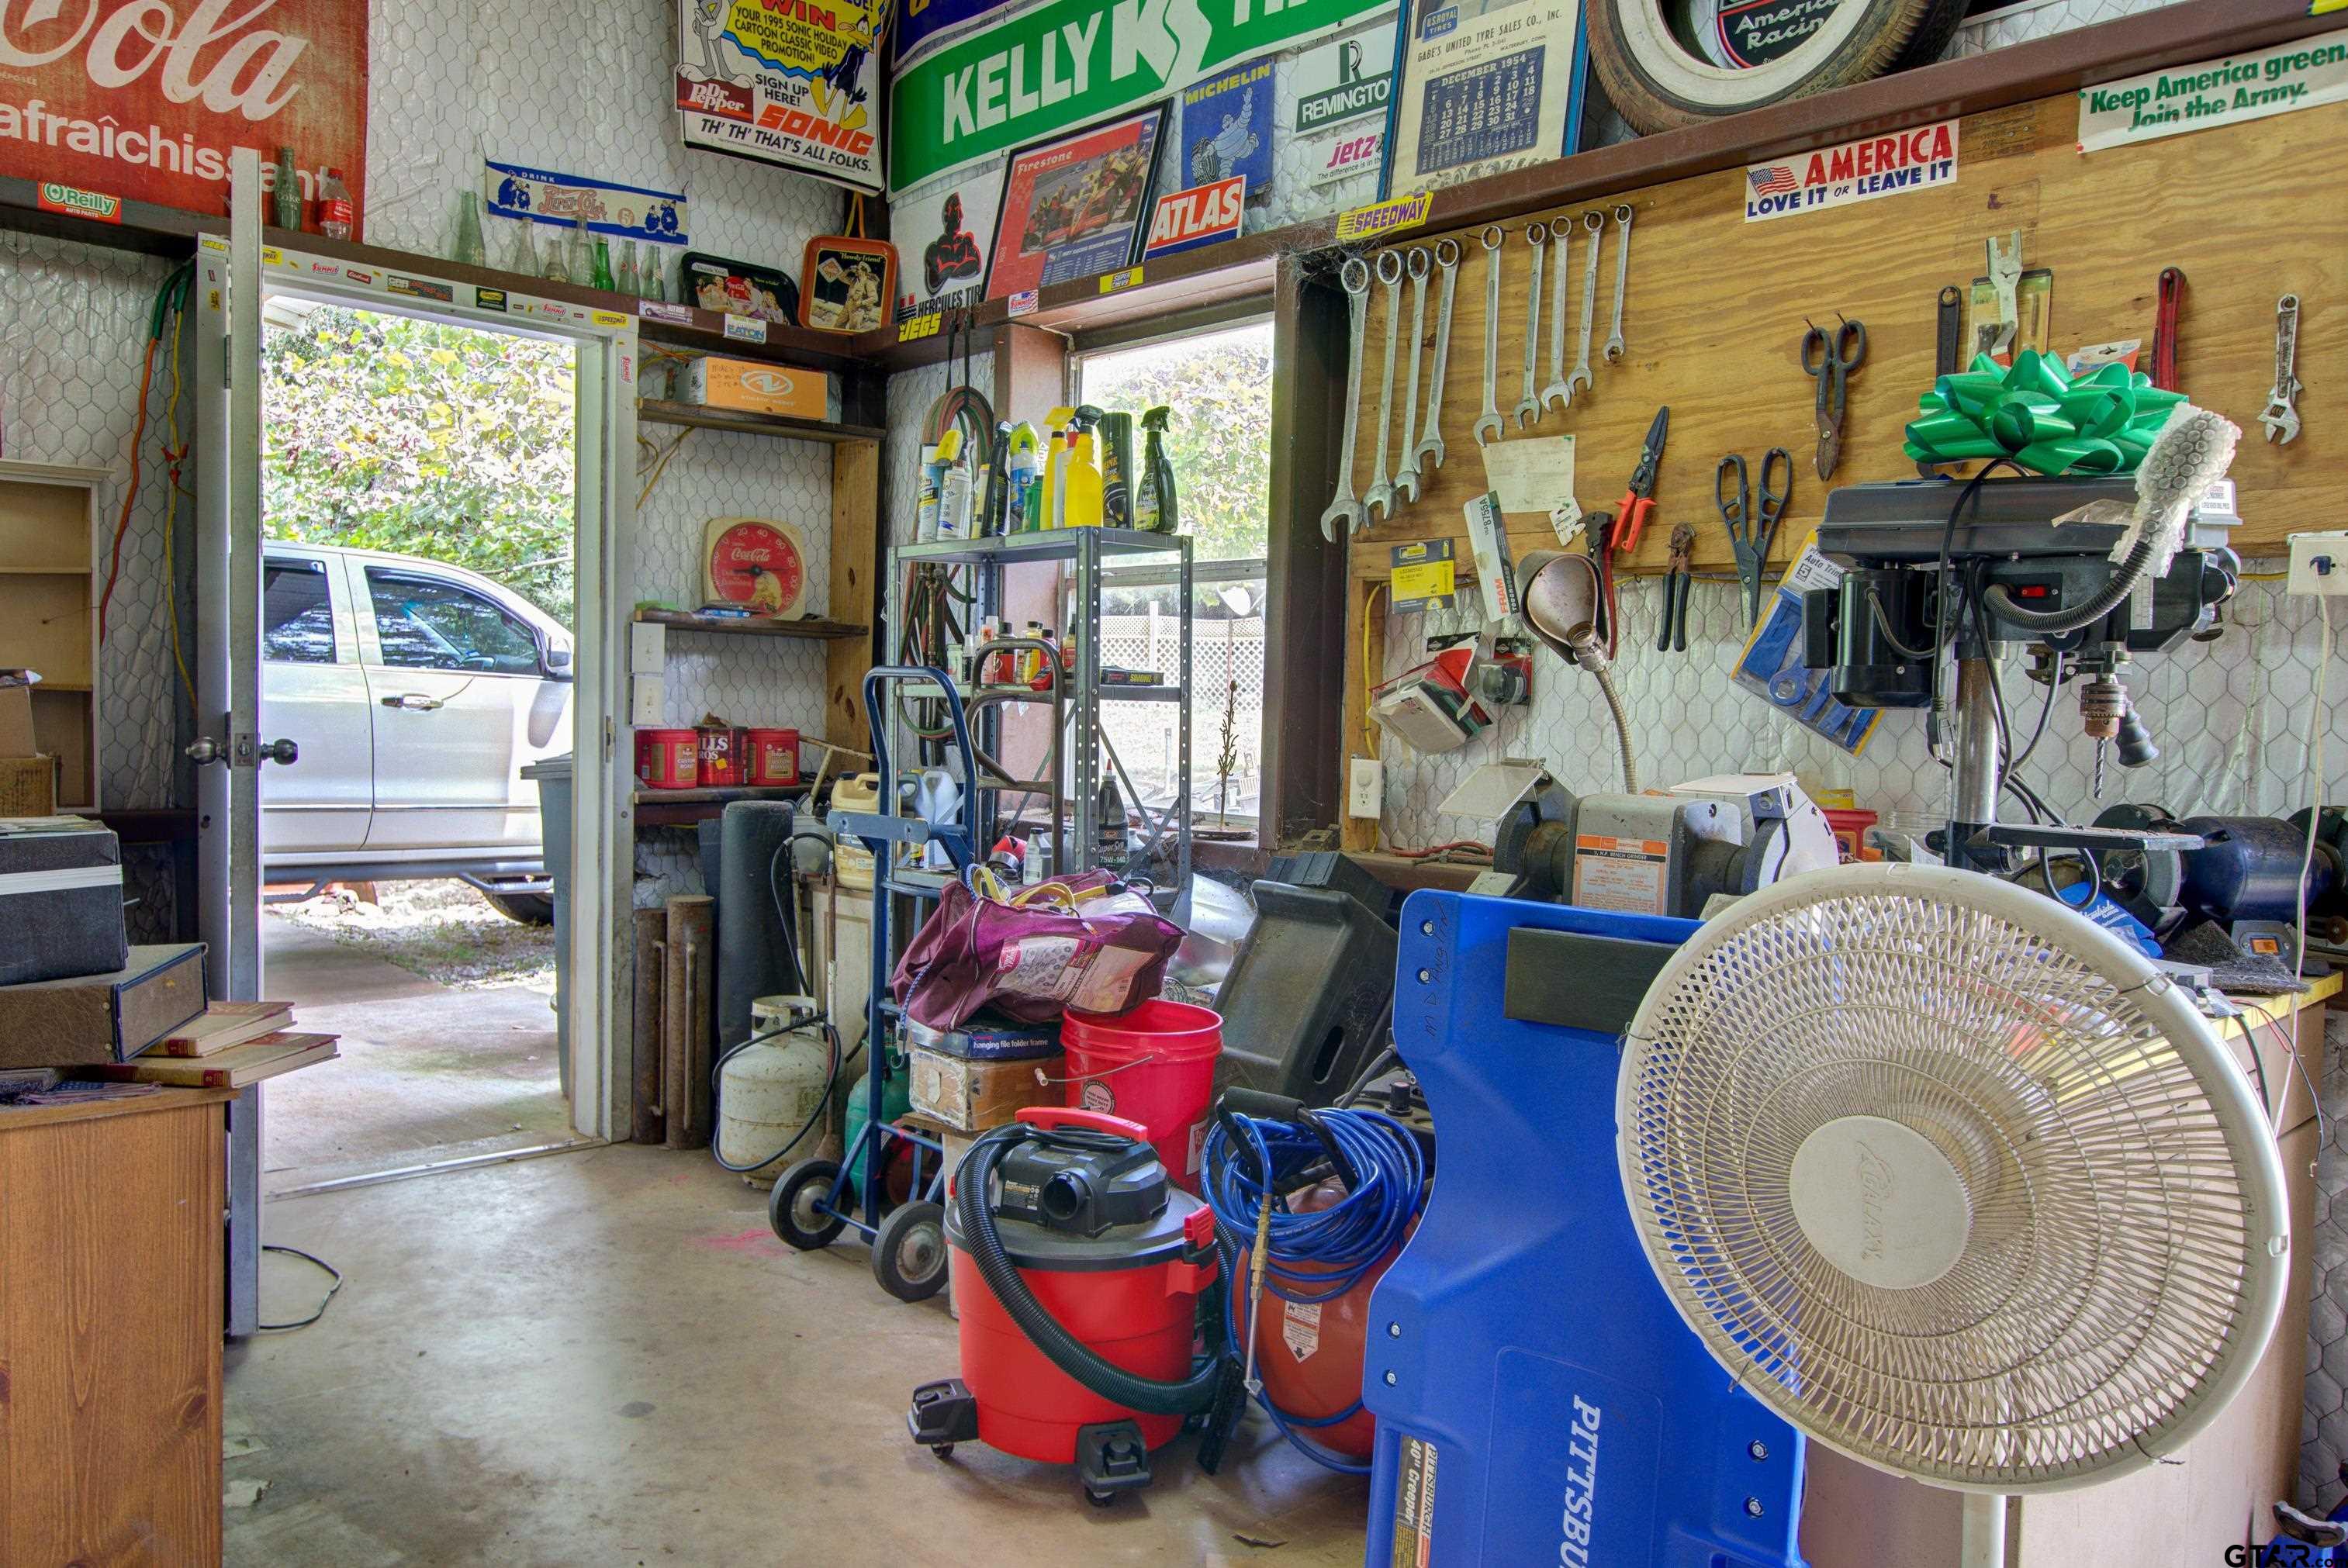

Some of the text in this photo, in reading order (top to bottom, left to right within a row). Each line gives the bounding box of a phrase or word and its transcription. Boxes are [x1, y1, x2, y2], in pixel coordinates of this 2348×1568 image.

[735, 19, 838, 60] CARTOON CLASSIC VIDEO
[736, 7, 847, 50] YOUR 1995 SONIC HOLIDAY
[1417, 45, 1441, 63] GABE'S
[1445, 36, 1472, 54] UNITED
[1476, 27, 1495, 43] TYRE
[1499, 19, 1522, 36] SALES
[1429, 22, 1452, 34] TIRES
[1746, 17, 1824, 50] Racin
[761, 39, 815, 64] PROMOTION!
[1339, 40, 1363, 84] R
[756, 74, 810, 96] SIGN UP
[943, 11, 1103, 145] KELLY
[1185, 64, 1271, 107] MICHELIN
[1441, 54, 1527, 87] DECEMBER 1954
[1478, 64, 1535, 89] 1 2 3 4
[2090, 43, 2348, 114] Keep America green.
[689, 83, 745, 112] Pepper
[707, 83, 729, 100] Dr
[764, 88, 801, 107] HERE!
[1302, 78, 1391, 124] REMINGTO
[1441, 85, 1536, 119] 13 14 15 16 17 18
[1445, 75, 1536, 109] 6 7 8 9 10 11
[2128, 81, 2308, 133] Join the Army.
[756, 103, 876, 157] SONIC
[1440, 101, 1517, 130] 20 21 22 23 24
[1440, 112, 1516, 140] 27 28 29 30 31
[0, 99, 329, 202] afraîchisant
[700, 118, 724, 134] TH'
[728, 124, 752, 140] TH'
[755, 130, 801, 153] THAT'S
[802, 145, 825, 161] ALL
[828, 150, 872, 172] FOLKS.
[1017, 150, 1074, 174] Firestone
[1803, 124, 1954, 188] AMERICA
[521, 171, 555, 183] DRINK
[1317, 171, 1329, 181] The
[1330, 163, 1359, 178] difference
[1367, 158, 1373, 167] in
[1747, 160, 1953, 219] LOVE IT OR LEAVE IT
[1149, 181, 1241, 245] ATLAS
[1354, 198, 1425, 233] SPEEDWAY
[918, 284, 981, 318] HERCULES TIR
[898, 313, 942, 343] JEGS
[757, 529, 768, 537] 40
[1804, 554, 1823, 569] Auto
[1494, 577, 1509, 614] FRAM
[973, 1041, 1000, 1051] hanging
[1409, 1439, 1423, 1467] 40"
[1403, 1468, 1420, 1525] Creeper
[1423, 1445, 1437, 1536] PITTSBURGH
[1558, 1394, 1602, 1568] PITTSBU
